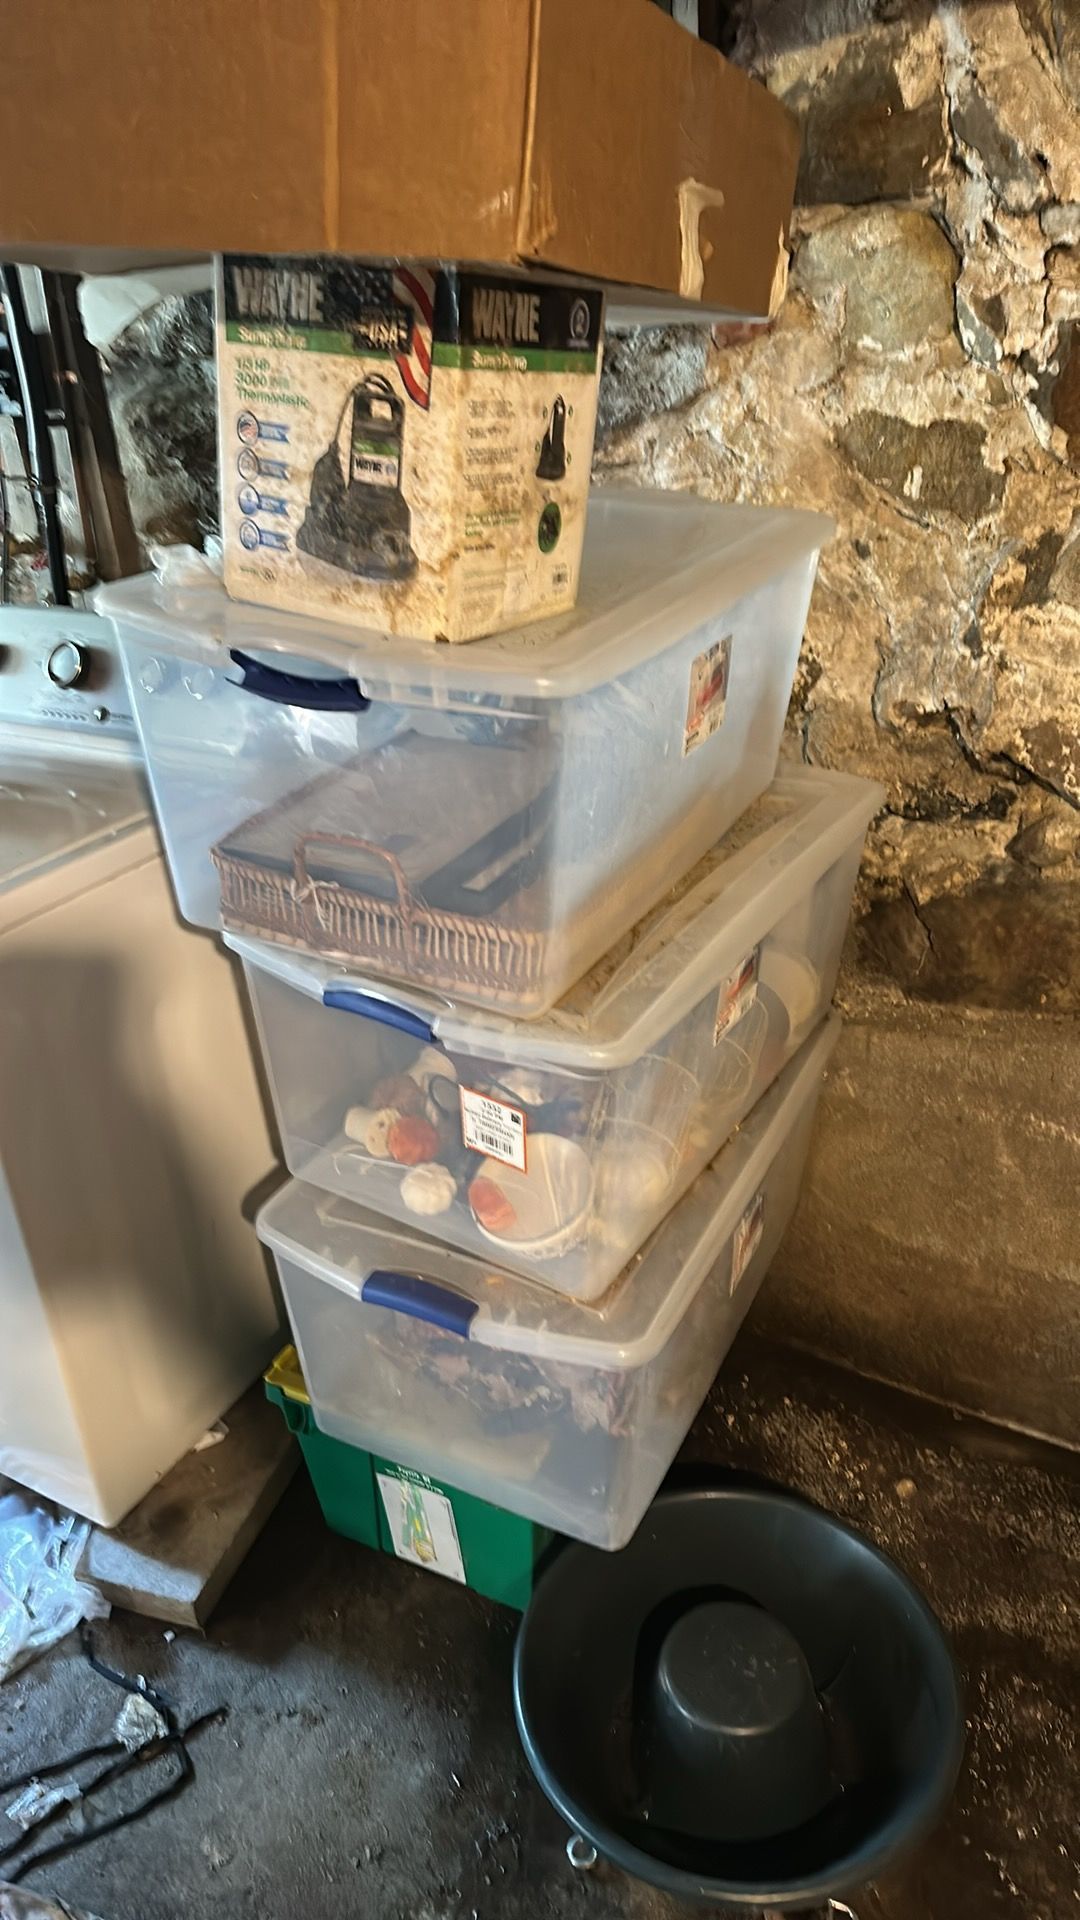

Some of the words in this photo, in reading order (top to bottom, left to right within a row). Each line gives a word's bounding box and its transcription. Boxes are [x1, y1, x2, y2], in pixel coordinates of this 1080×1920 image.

[234, 266, 323, 321] WAYNE
[472, 288, 541, 343] WAYNE
[236, 372, 268, 387] 3000
[236, 388, 311, 408] Thermoplastic
